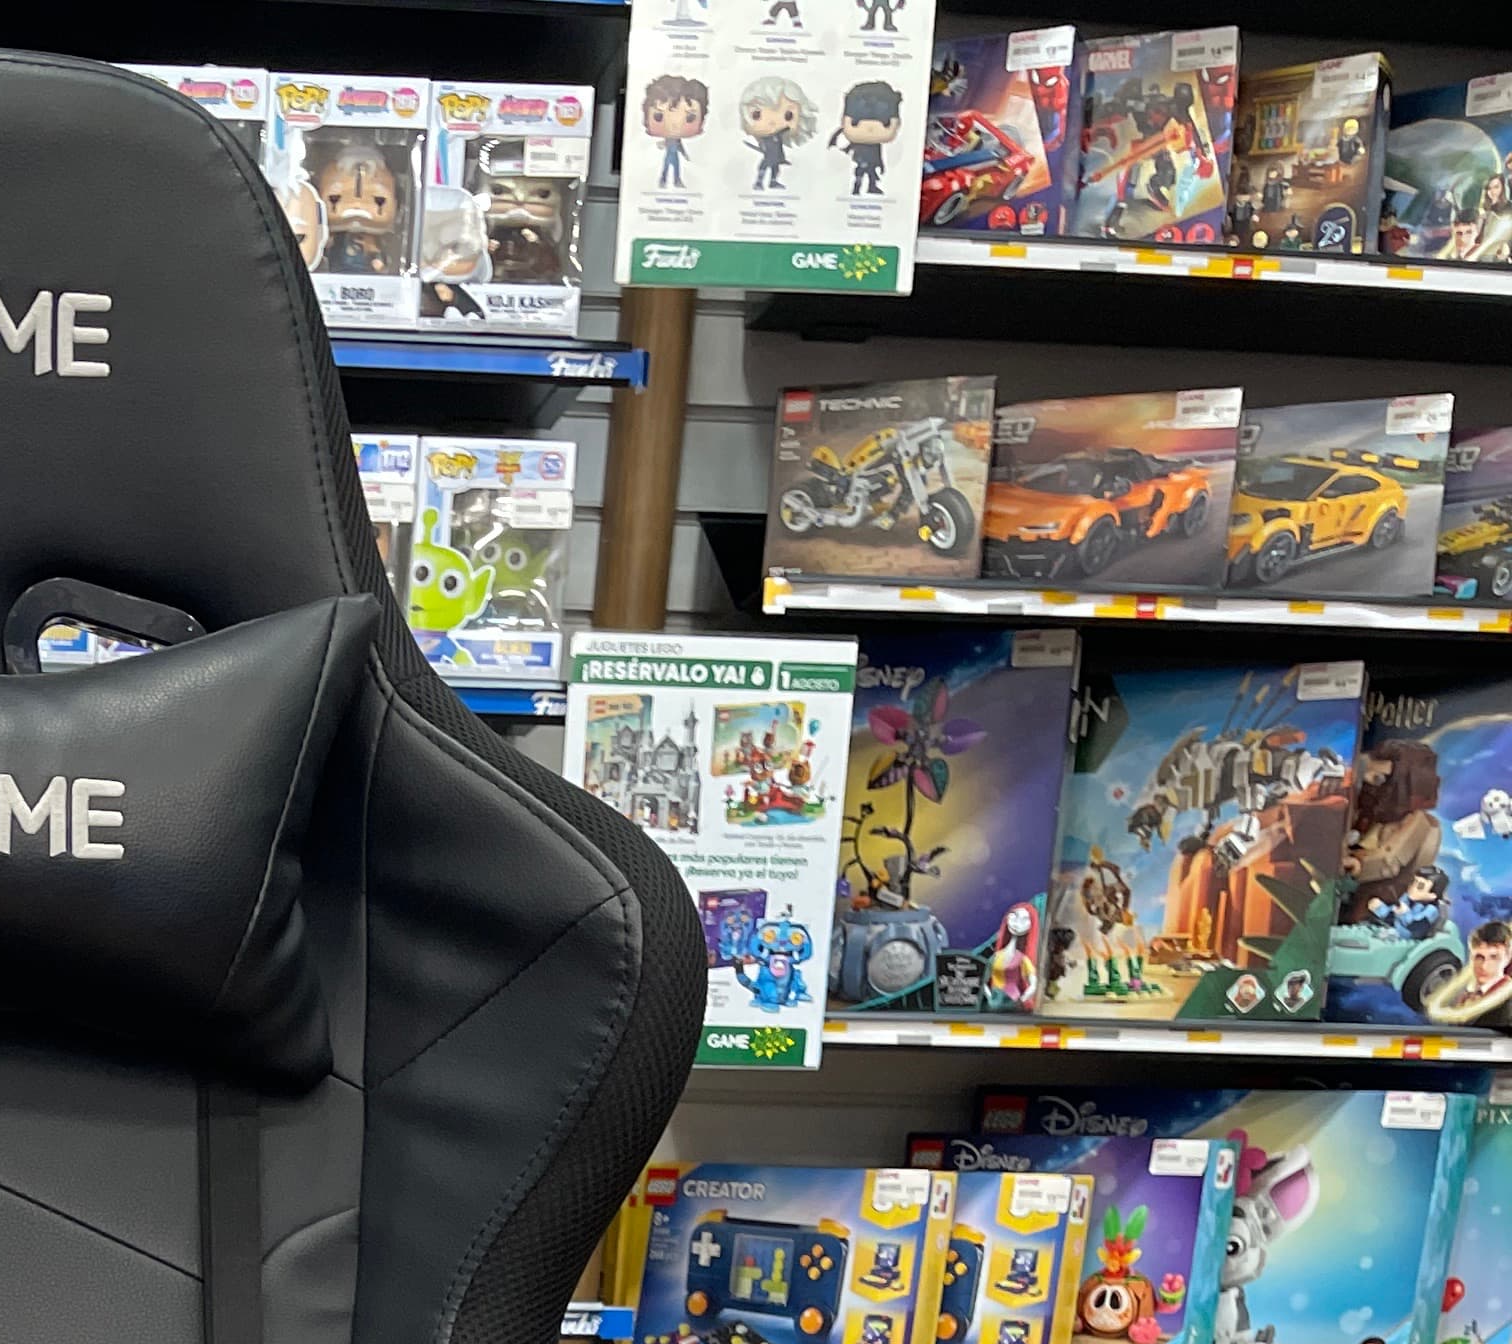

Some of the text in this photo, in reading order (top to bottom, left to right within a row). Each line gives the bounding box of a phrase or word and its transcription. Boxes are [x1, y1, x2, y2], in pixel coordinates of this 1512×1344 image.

[791, 252, 839, 270] GAME
[819, 396, 903, 412] TECHNIC
[582, 658, 746, 686] ¡RESÉRVALO YA!
[780, 671, 790, 690] 1
[706, 1033, 751, 1051] GAME
[682, 1180, 766, 1200] CREATOR
